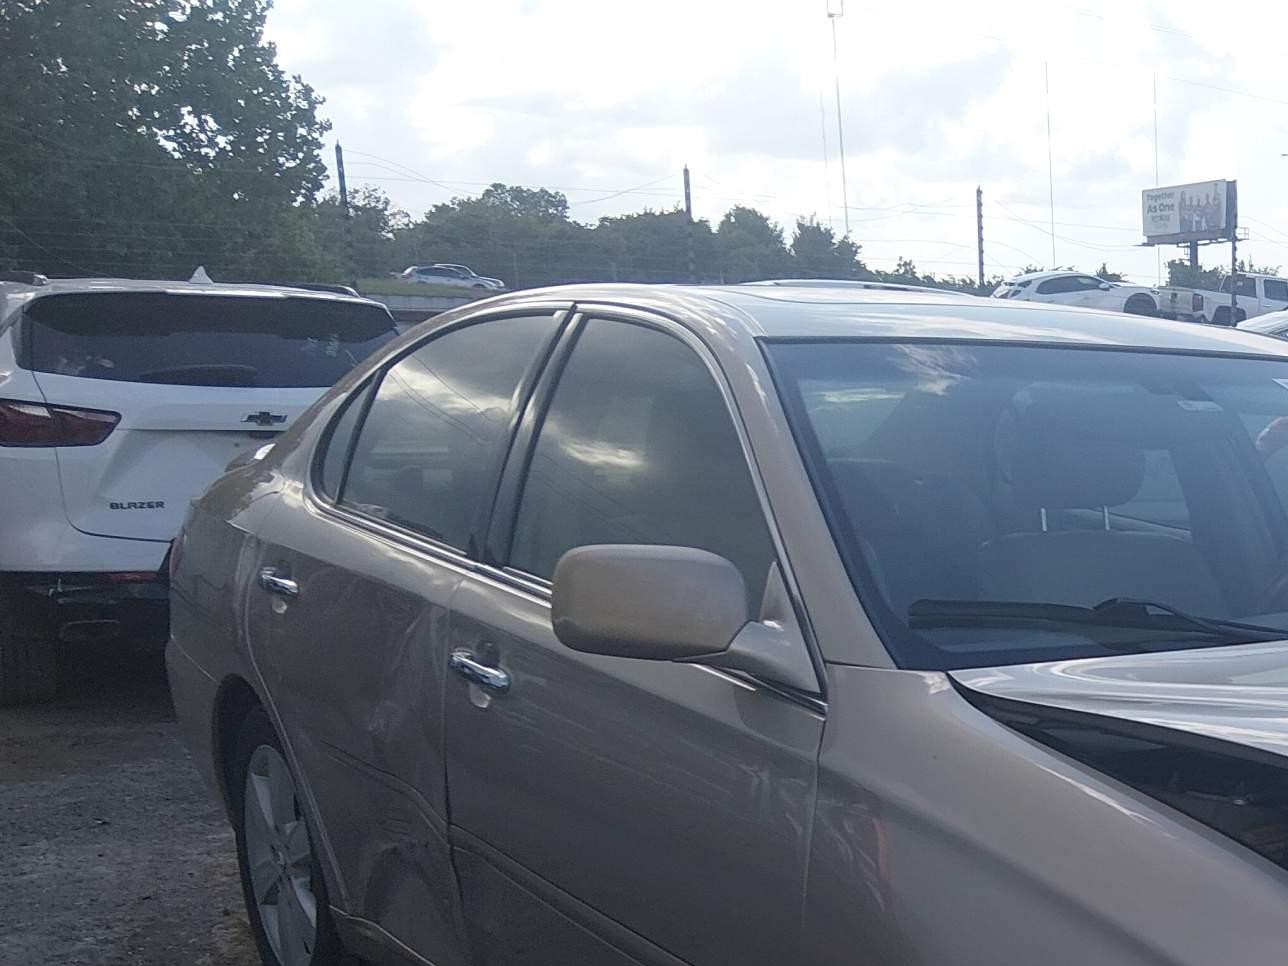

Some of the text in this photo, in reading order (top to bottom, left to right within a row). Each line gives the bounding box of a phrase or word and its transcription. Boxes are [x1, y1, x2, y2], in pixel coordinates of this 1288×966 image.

[1147, 203, 1175, 214] As One
[110, 501, 165, 510] BLAZER
